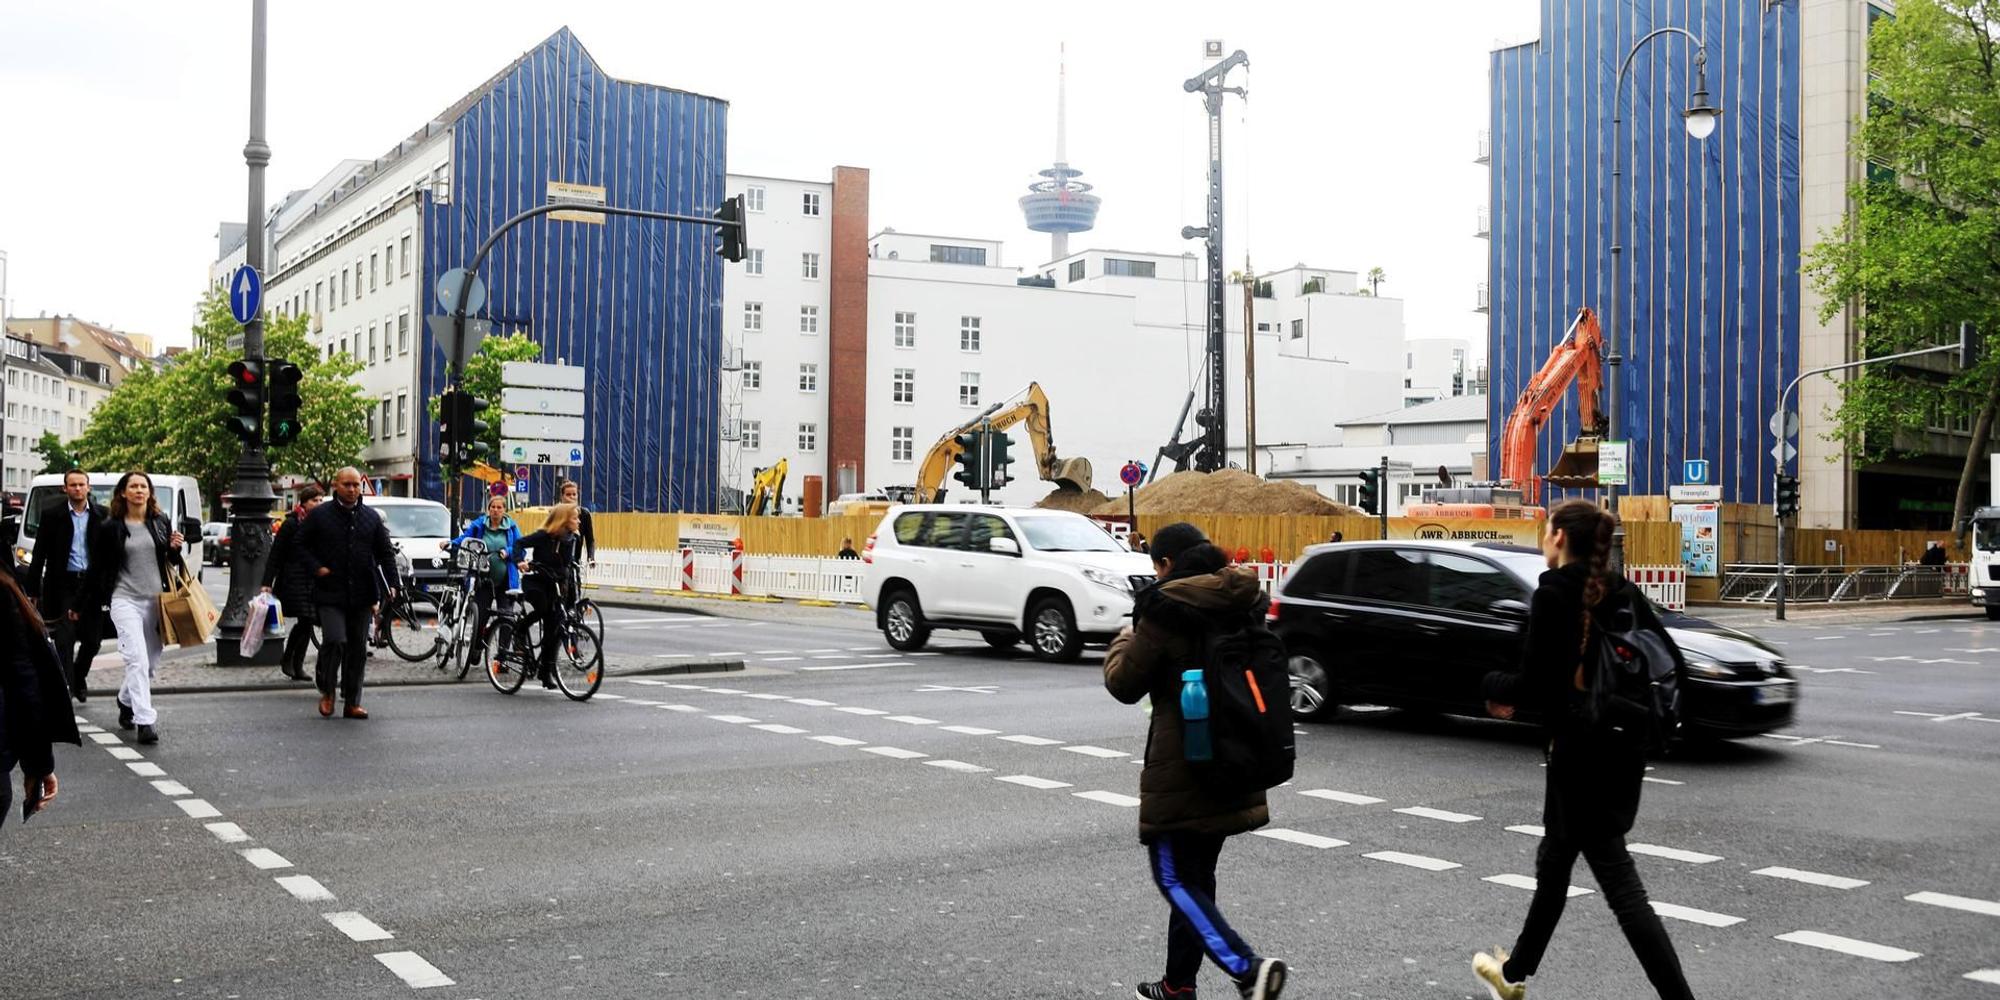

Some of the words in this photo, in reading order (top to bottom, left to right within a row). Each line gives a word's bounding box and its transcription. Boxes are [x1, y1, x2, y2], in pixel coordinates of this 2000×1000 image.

[1688, 463, 1703, 481] U
[1435, 509, 1473, 518] ABBRUCH
[1420, 530, 1444, 540] AWR
[1450, 530, 1498, 540] ABBRUCH
